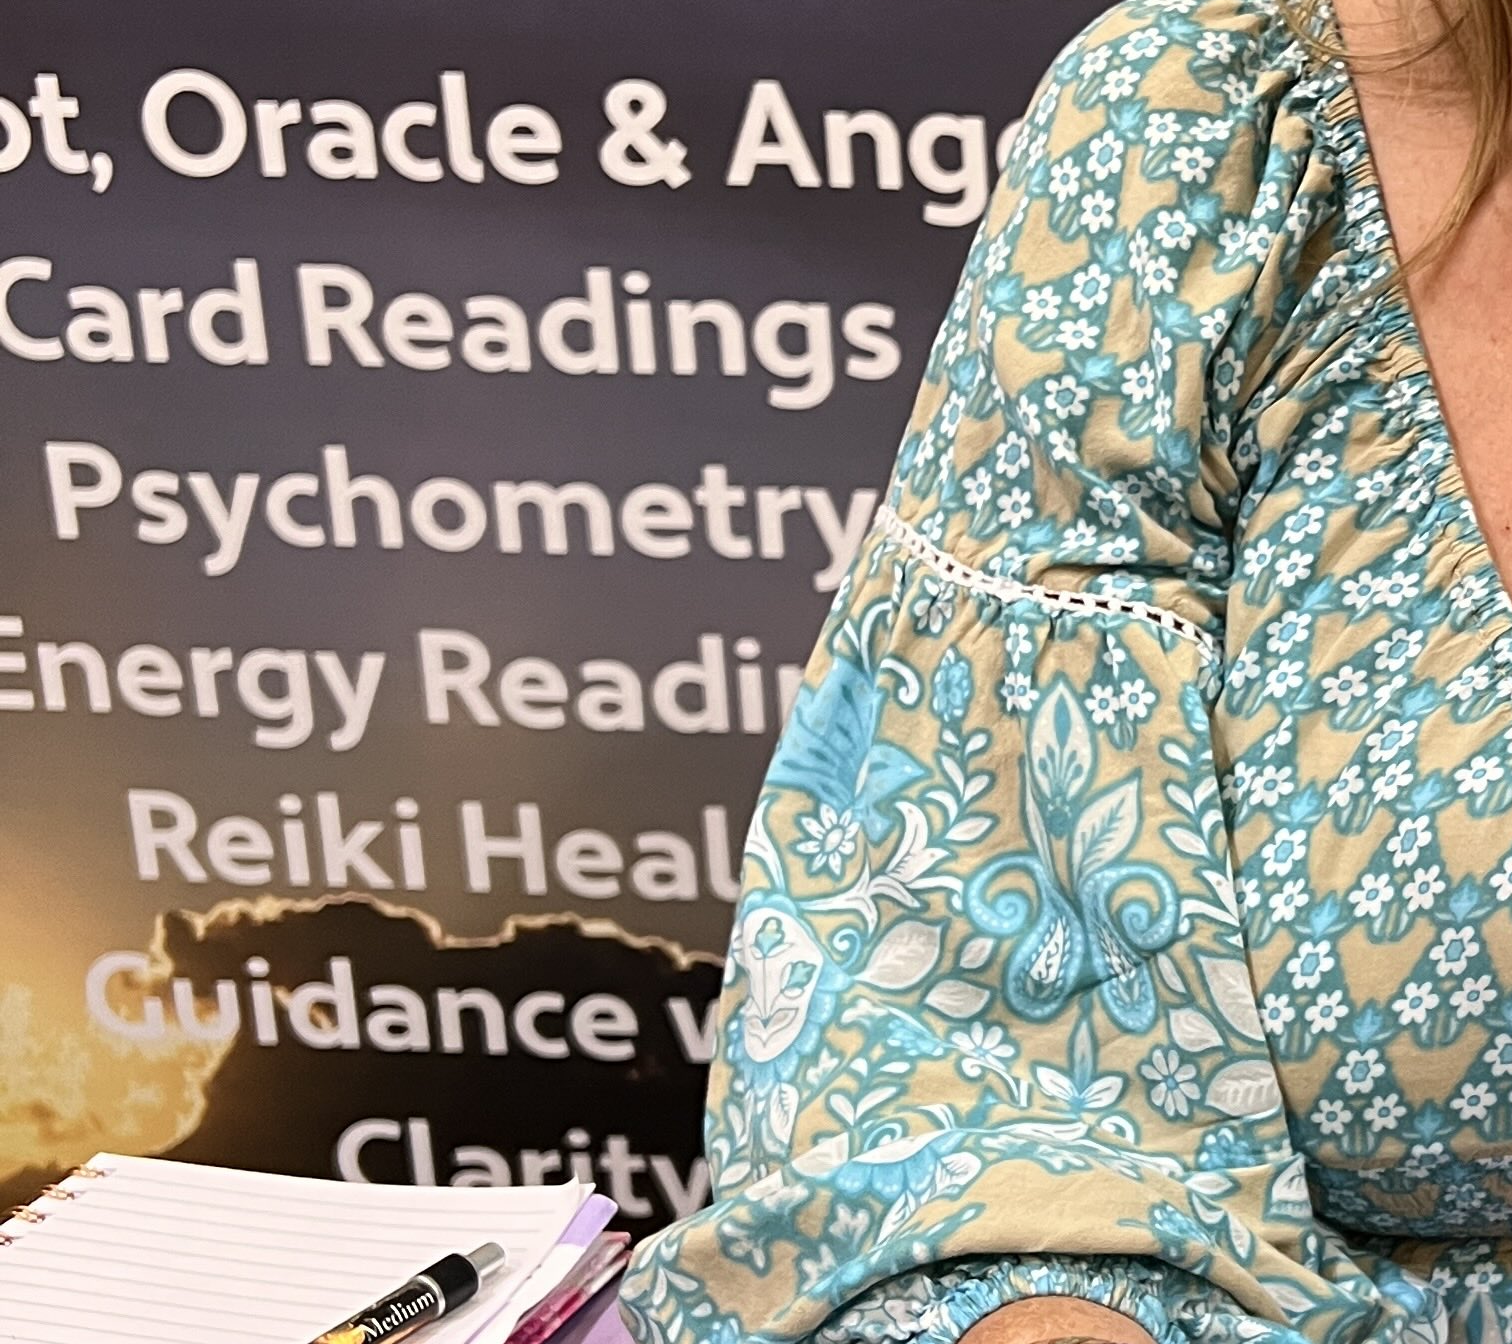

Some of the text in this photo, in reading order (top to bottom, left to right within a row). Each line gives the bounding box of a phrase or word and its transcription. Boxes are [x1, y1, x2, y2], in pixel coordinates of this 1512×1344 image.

[140, 68, 563, 185] Oracle
[598, 80, 692, 190] &
[725, 79, 1026, 228] Ang
[0, 258, 902, 410] Card Readings
[45, 440, 878, 593] Psychometry
[0, 616, 387, 752] Energy
[126, 788, 428, 892] Reiki
[83, 950, 640, 1058] Guidance
[361, 1291, 436, 1344] Medium
